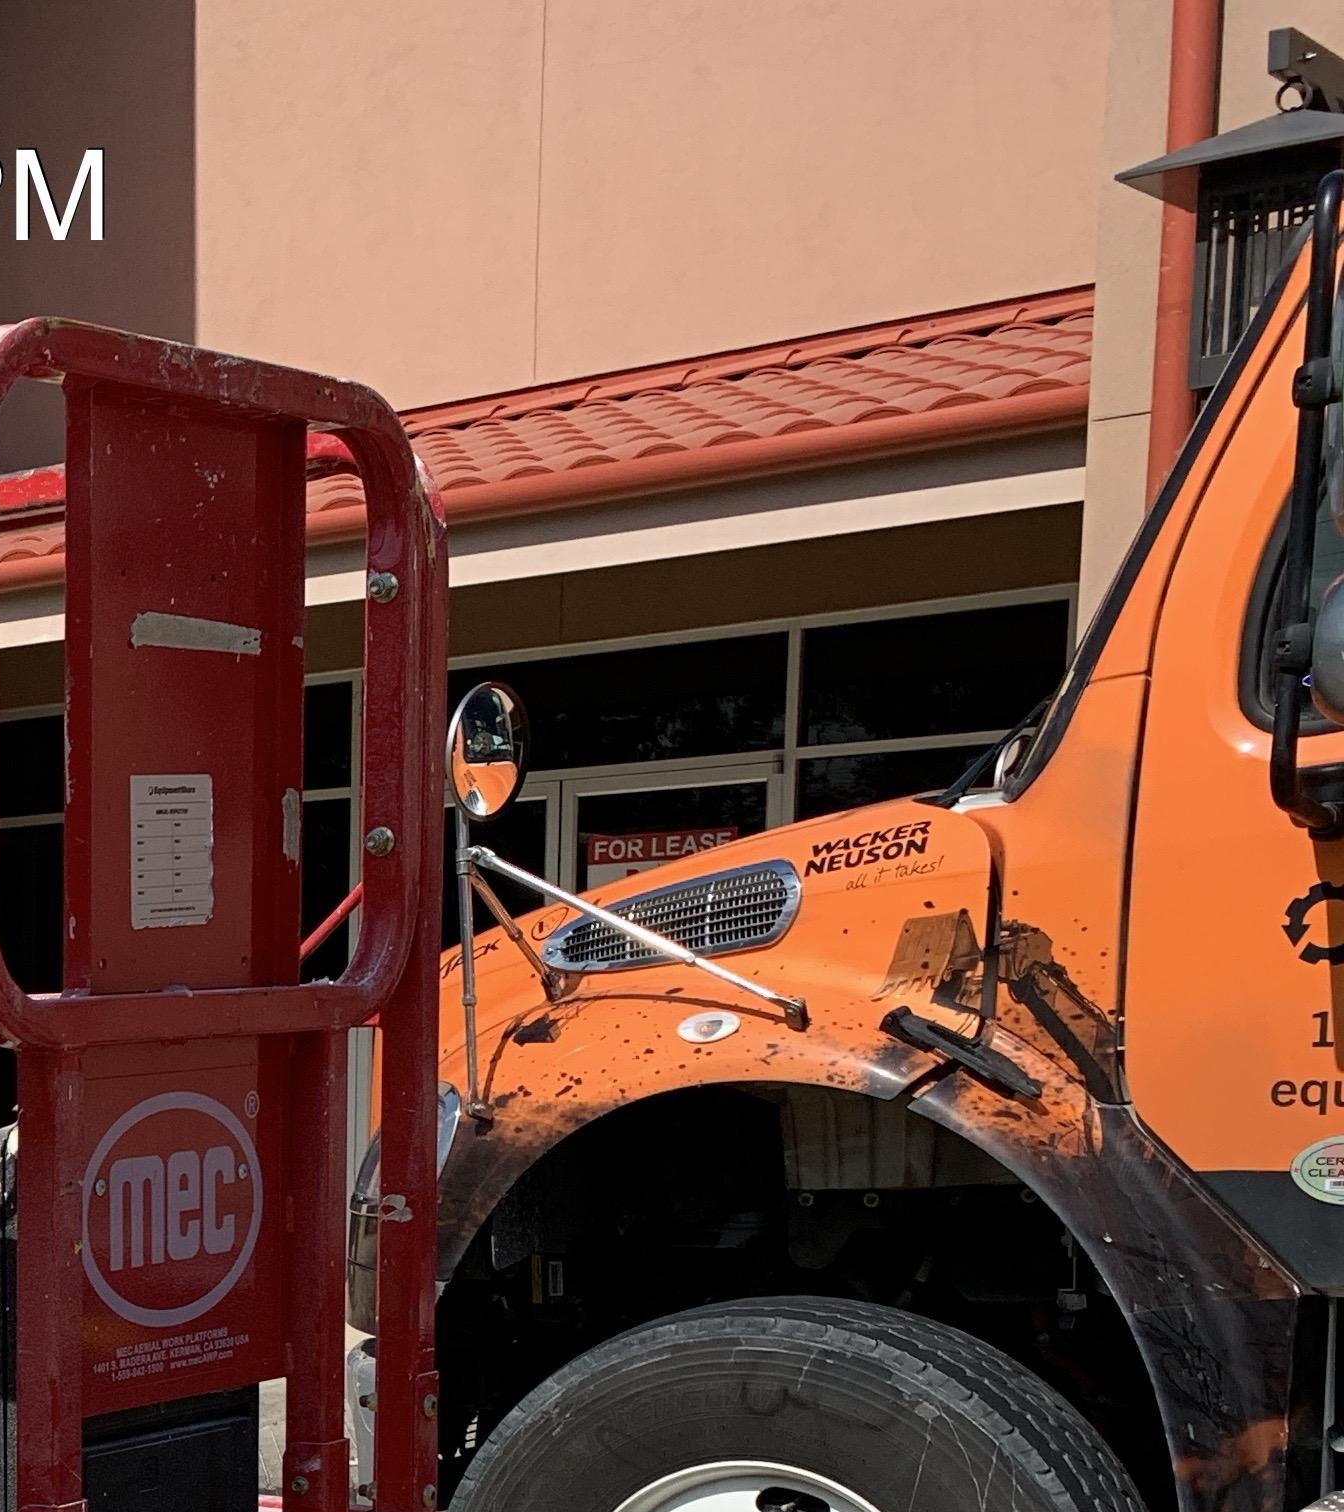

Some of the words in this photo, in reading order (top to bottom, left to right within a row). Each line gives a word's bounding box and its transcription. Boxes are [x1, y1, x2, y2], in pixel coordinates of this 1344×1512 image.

[594, 838, 644, 861] FOR
[651, 832, 732, 857] LEASE
[812, 821, 932, 857] WACKER
[804, 837, 929, 877] NEUSON
[846, 873, 867, 891] all
[874, 867, 890, 884] it
[891, 856, 945, 879] takes!
[109, 1146, 236, 1272] mec
[116, 1345, 132, 1358] MEC
[162, 1335, 185, 1349] WORK
